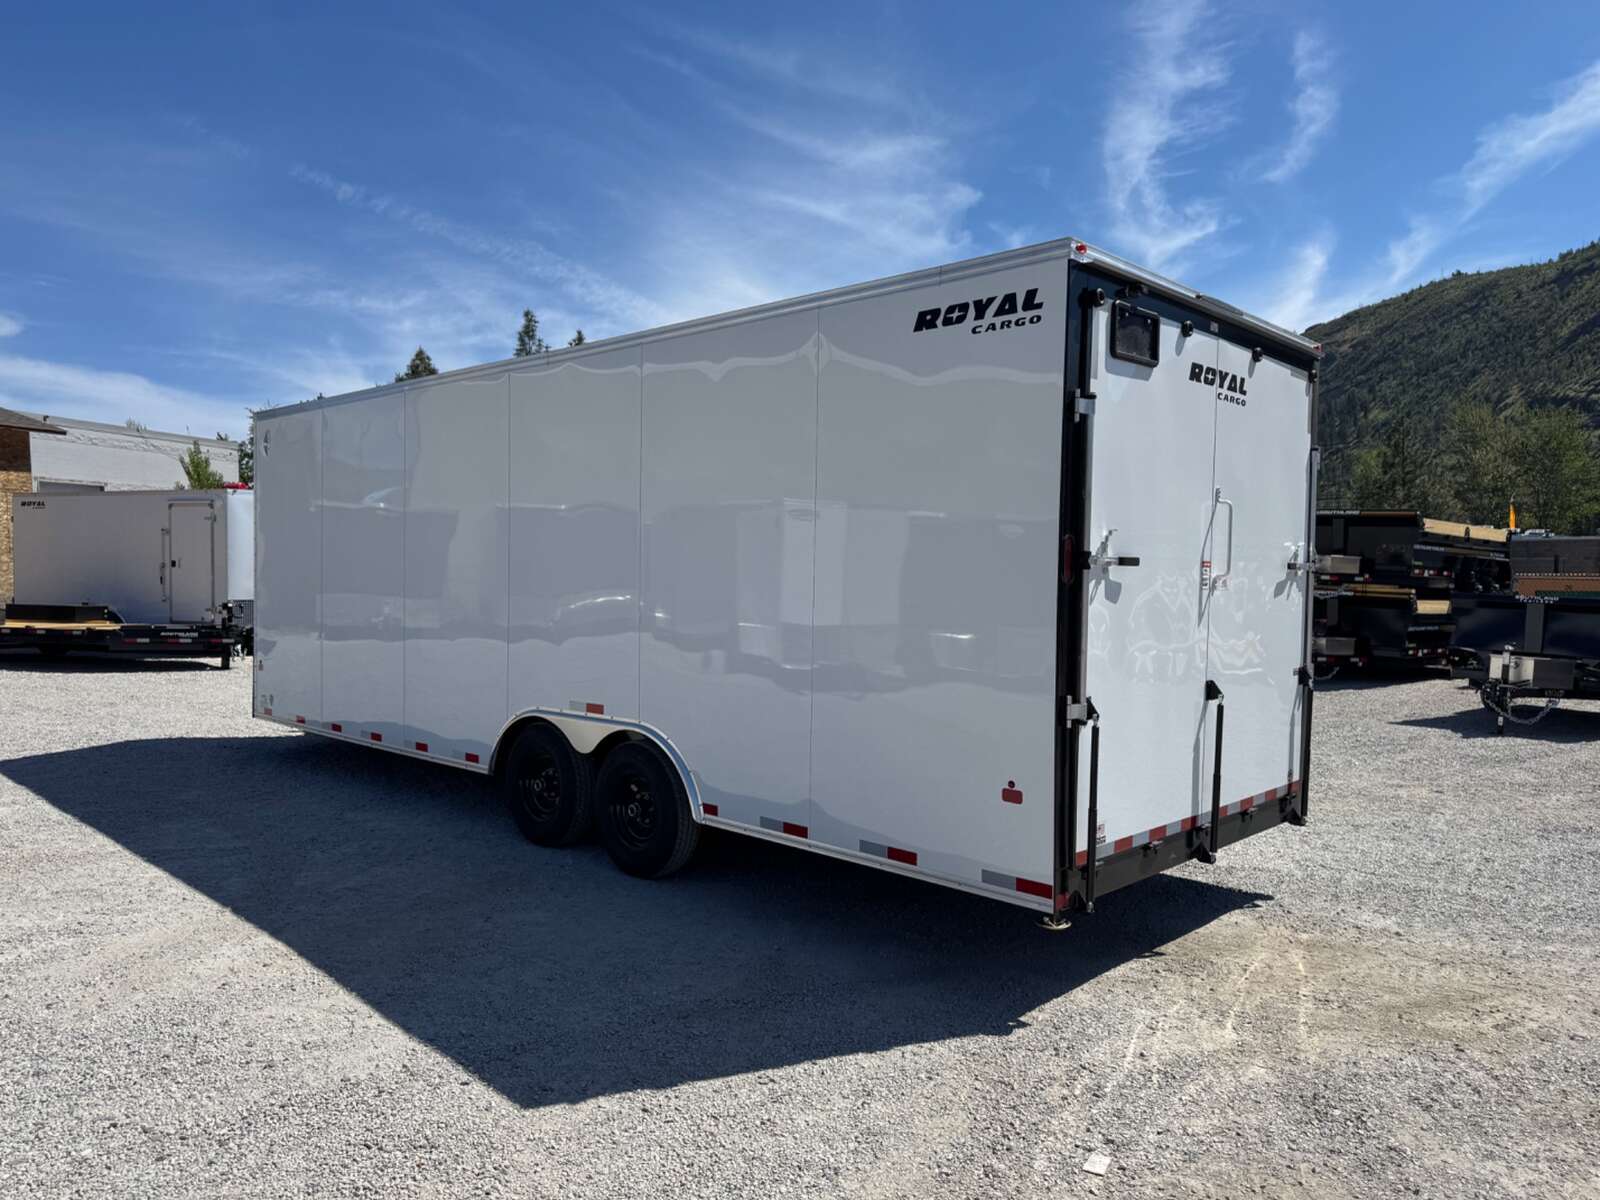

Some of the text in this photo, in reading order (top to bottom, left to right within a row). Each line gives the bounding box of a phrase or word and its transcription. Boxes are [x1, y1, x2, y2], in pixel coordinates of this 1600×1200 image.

[913, 288, 1044, 332] ROYAL
[971, 315, 1042, 334] CARGO
[1188, 361, 1247, 396] ROYAL
[1217, 392, 1246, 407] CARGO
